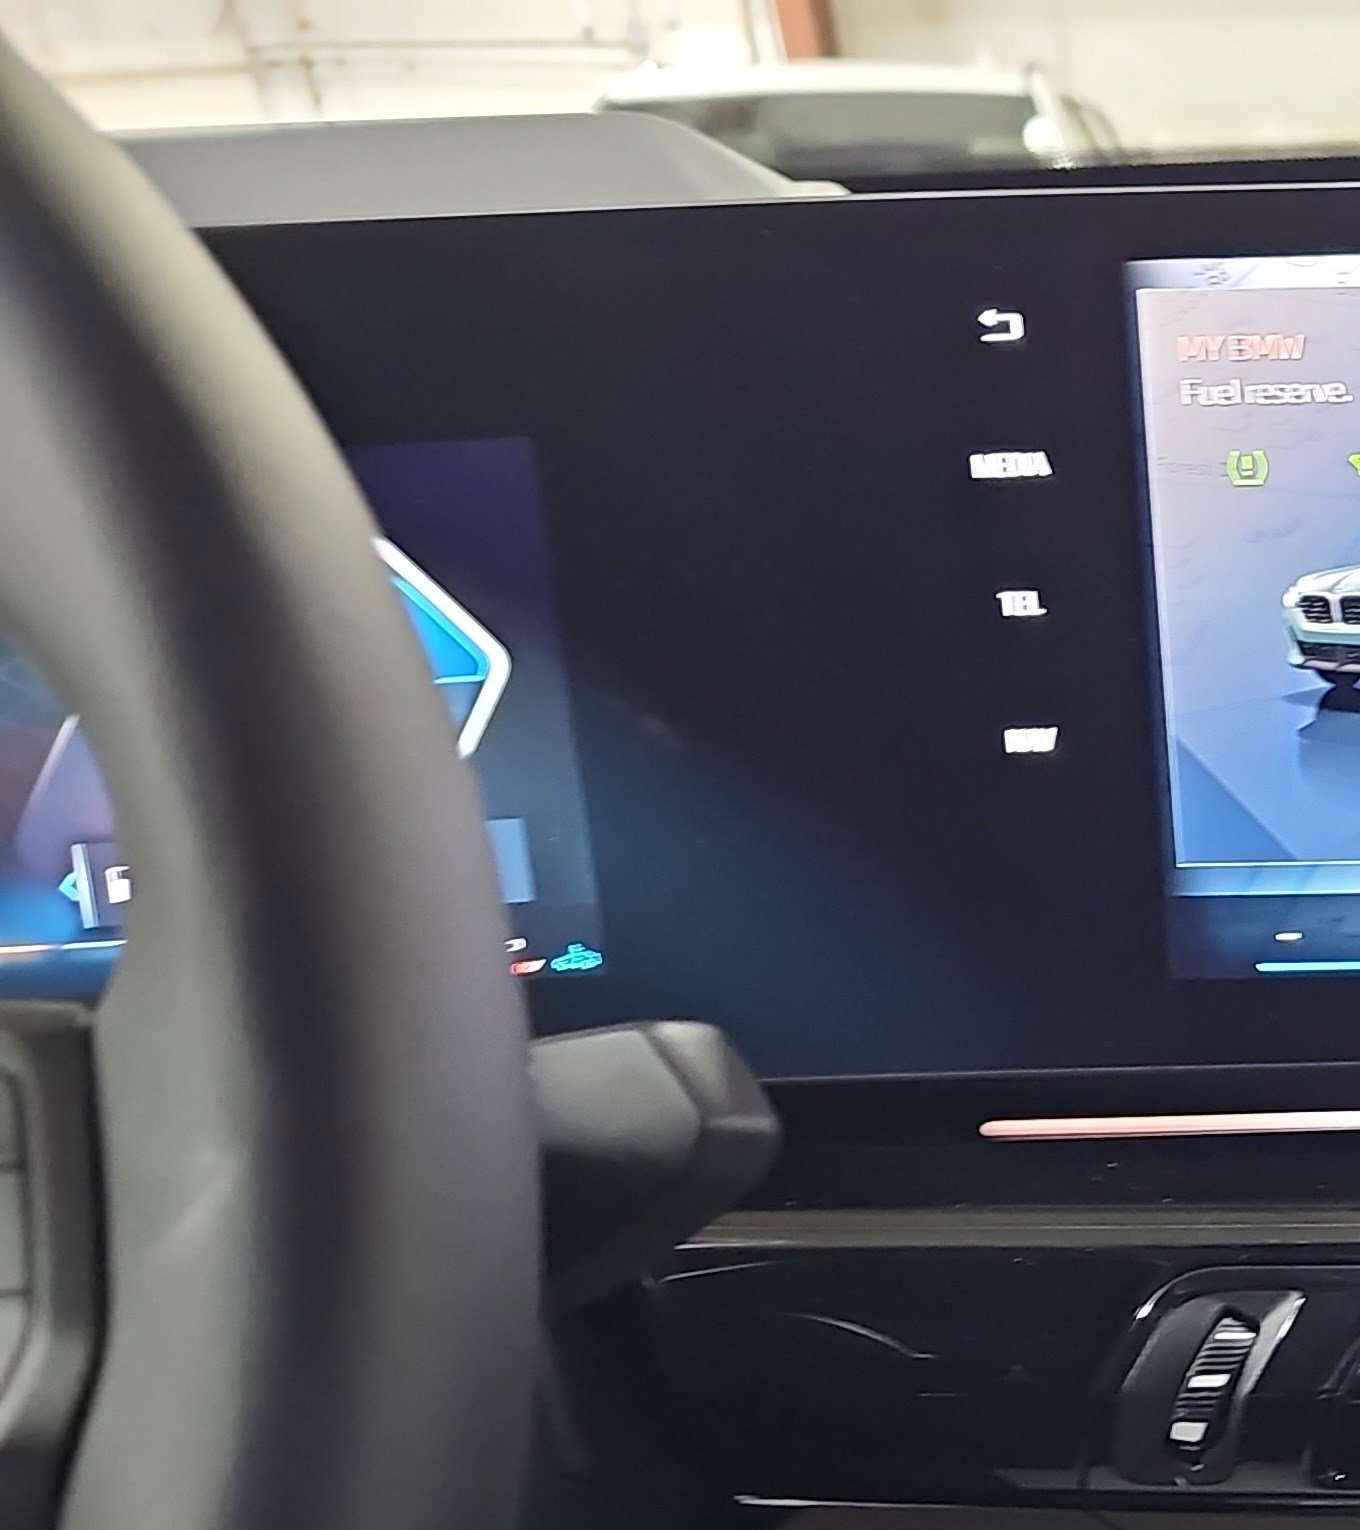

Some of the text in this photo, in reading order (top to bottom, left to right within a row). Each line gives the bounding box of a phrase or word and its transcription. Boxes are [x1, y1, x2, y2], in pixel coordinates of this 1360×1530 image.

[1176, 333, 1306, 361] MY BMW
[1179, 377, 1242, 406] Fuel
